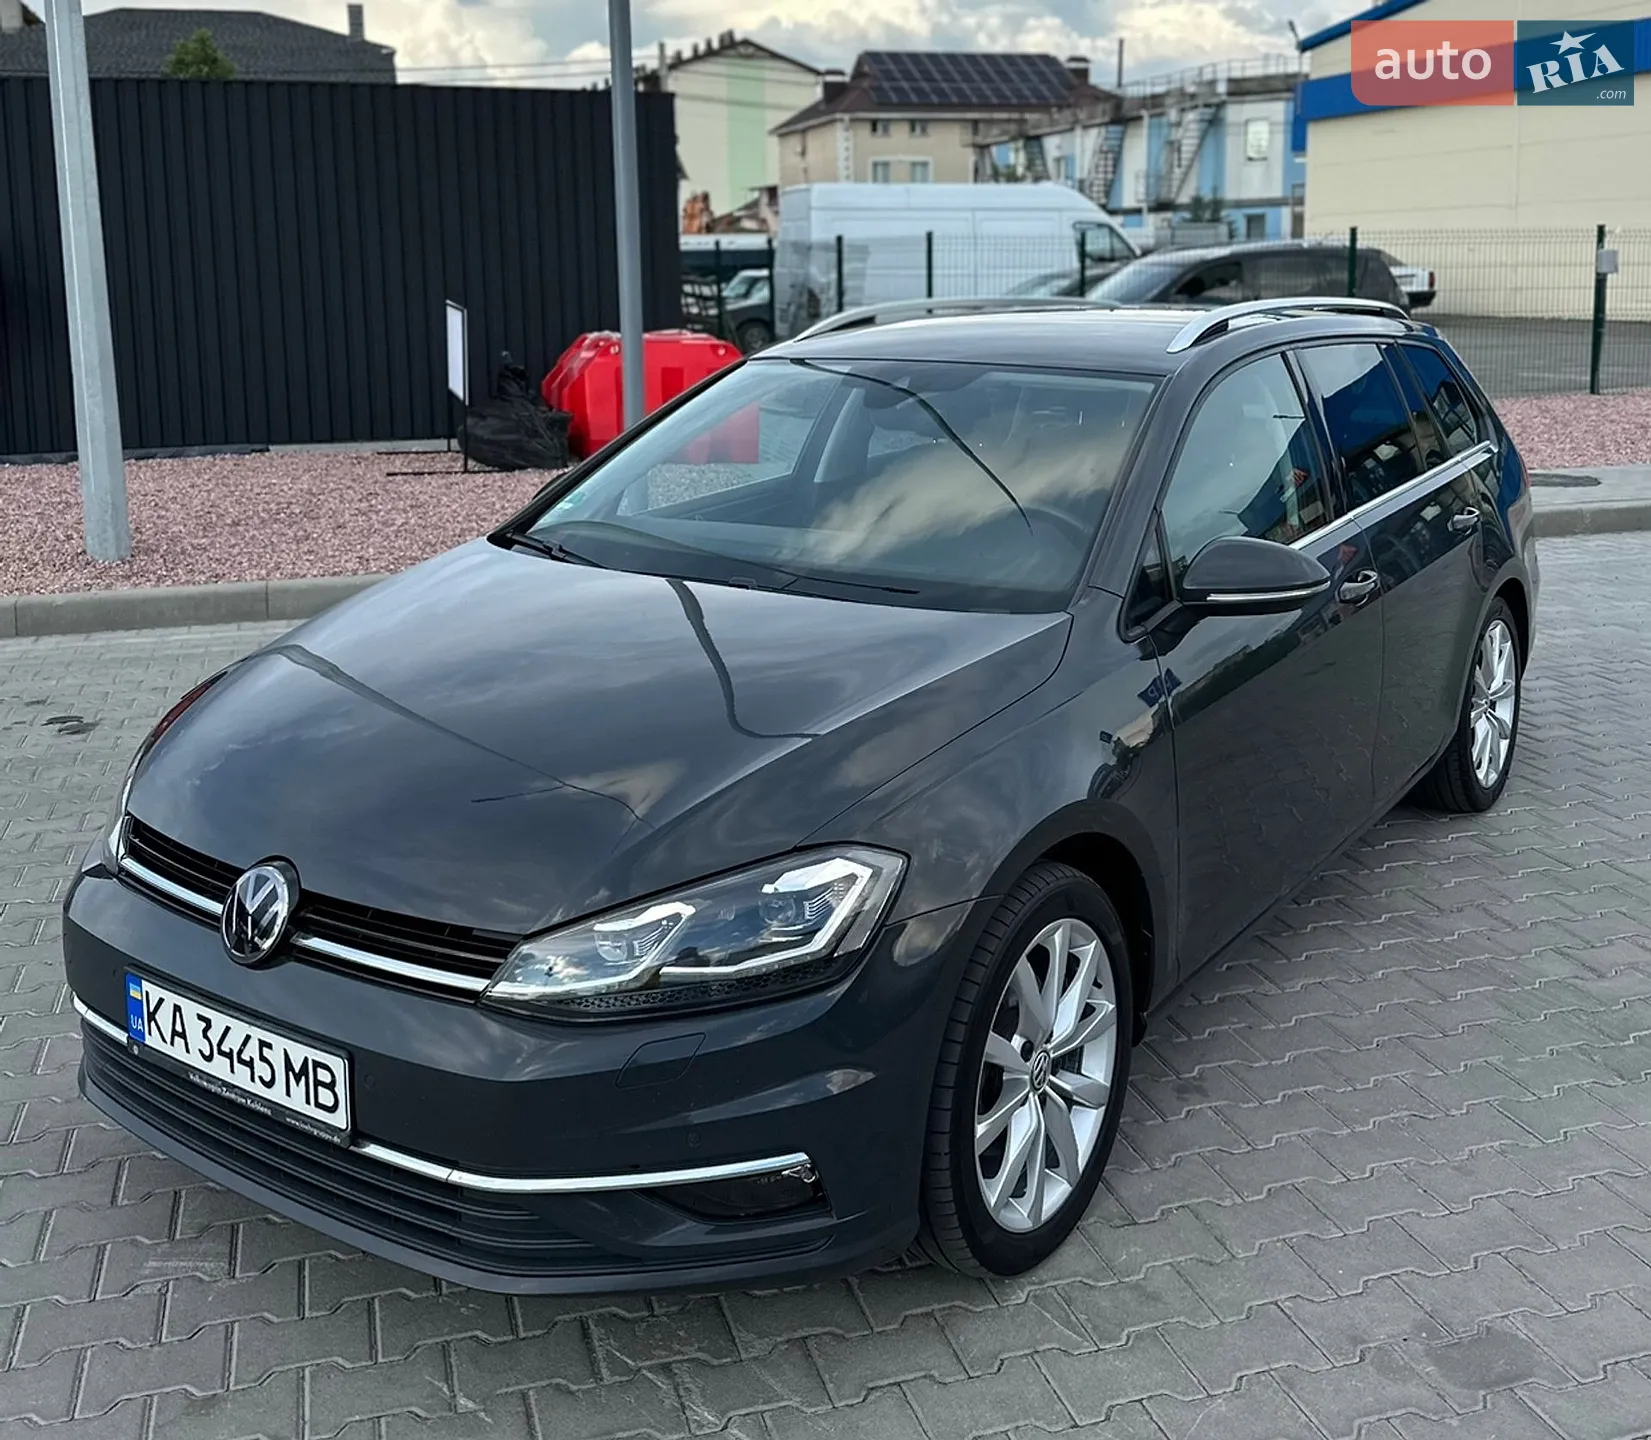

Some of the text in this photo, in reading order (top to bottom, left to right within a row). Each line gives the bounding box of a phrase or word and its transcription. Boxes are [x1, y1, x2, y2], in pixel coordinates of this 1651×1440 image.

[130, 1014, 144, 1032] UA
[144, 990, 191, 1055] KA
[196, 1012, 276, 1090] 3445
[283, 1047, 340, 1115] MB
